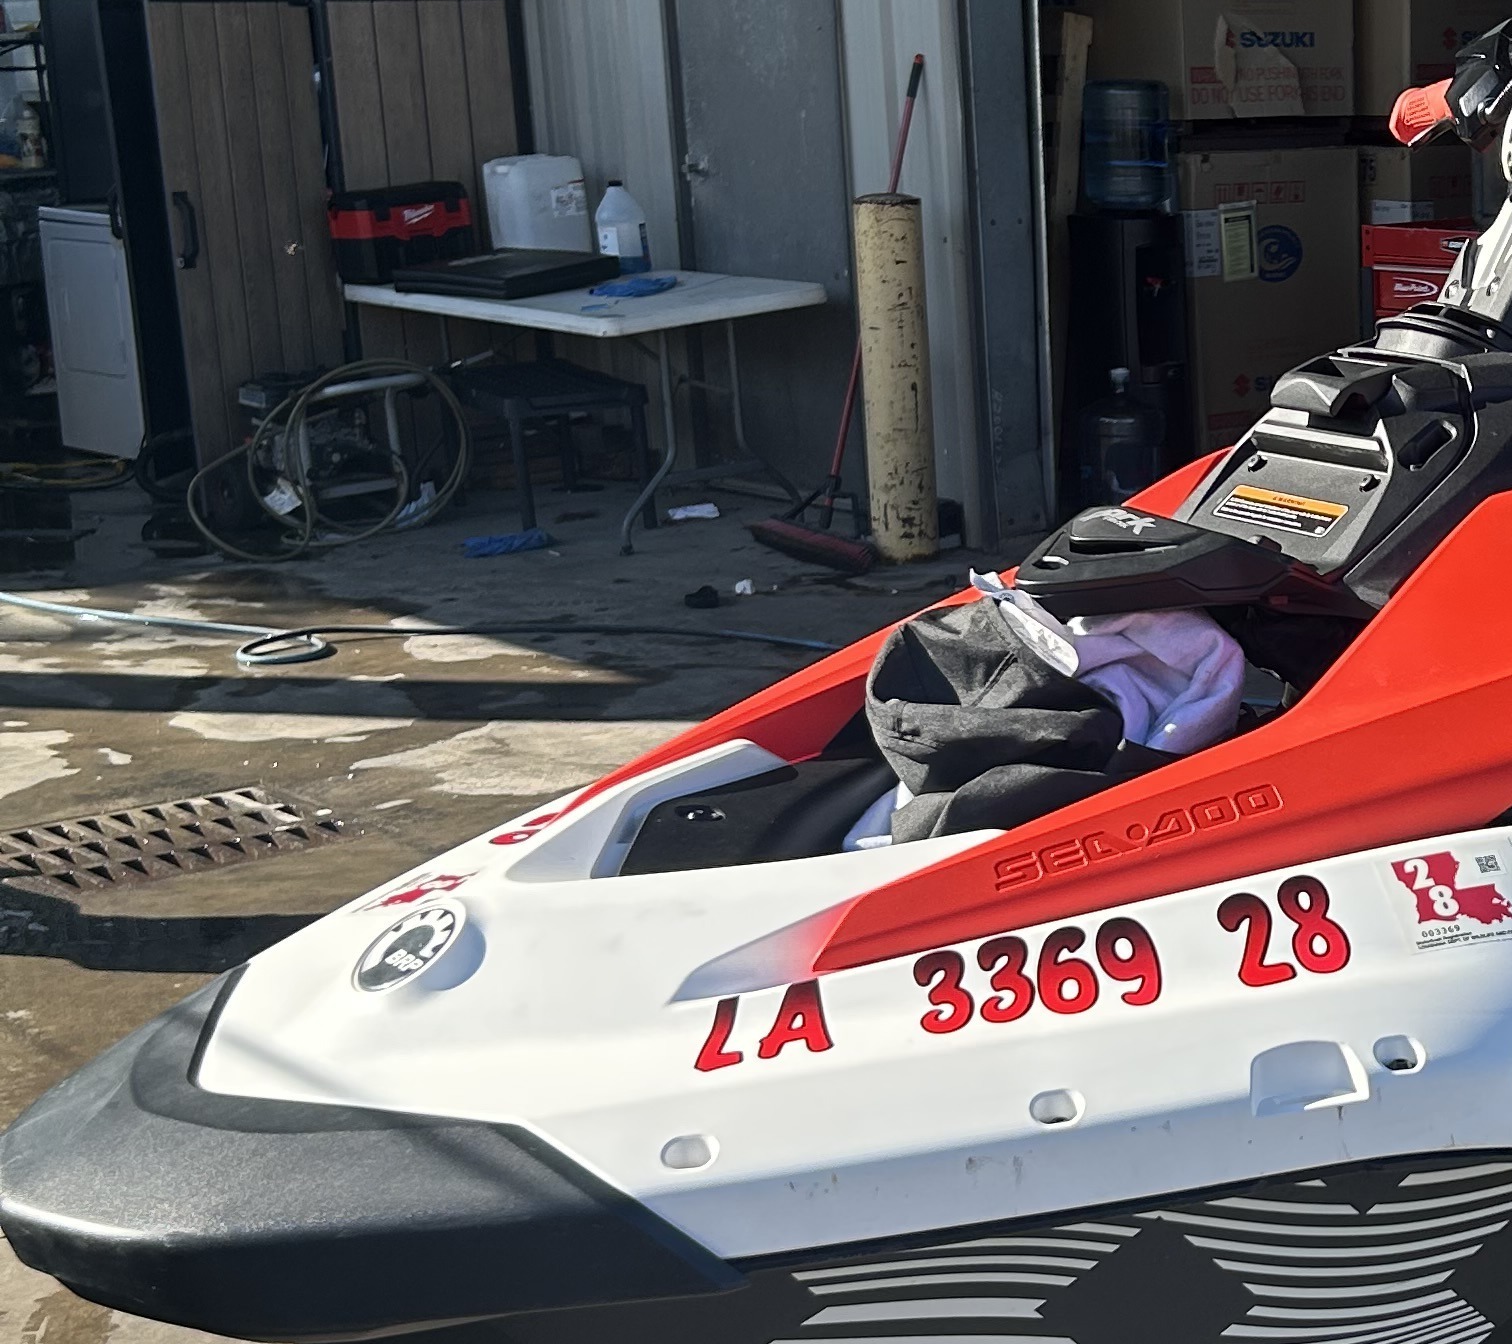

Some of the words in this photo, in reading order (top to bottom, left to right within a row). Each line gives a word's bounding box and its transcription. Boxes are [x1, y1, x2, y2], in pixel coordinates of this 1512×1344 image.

[1240, 31, 1315, 48] SUZUKI
[384, 948, 424, 972] BRP
[694, 978, 835, 1072] LA
[913, 917, 1163, 1034] 3369
[1217, 874, 1351, 987] 28
